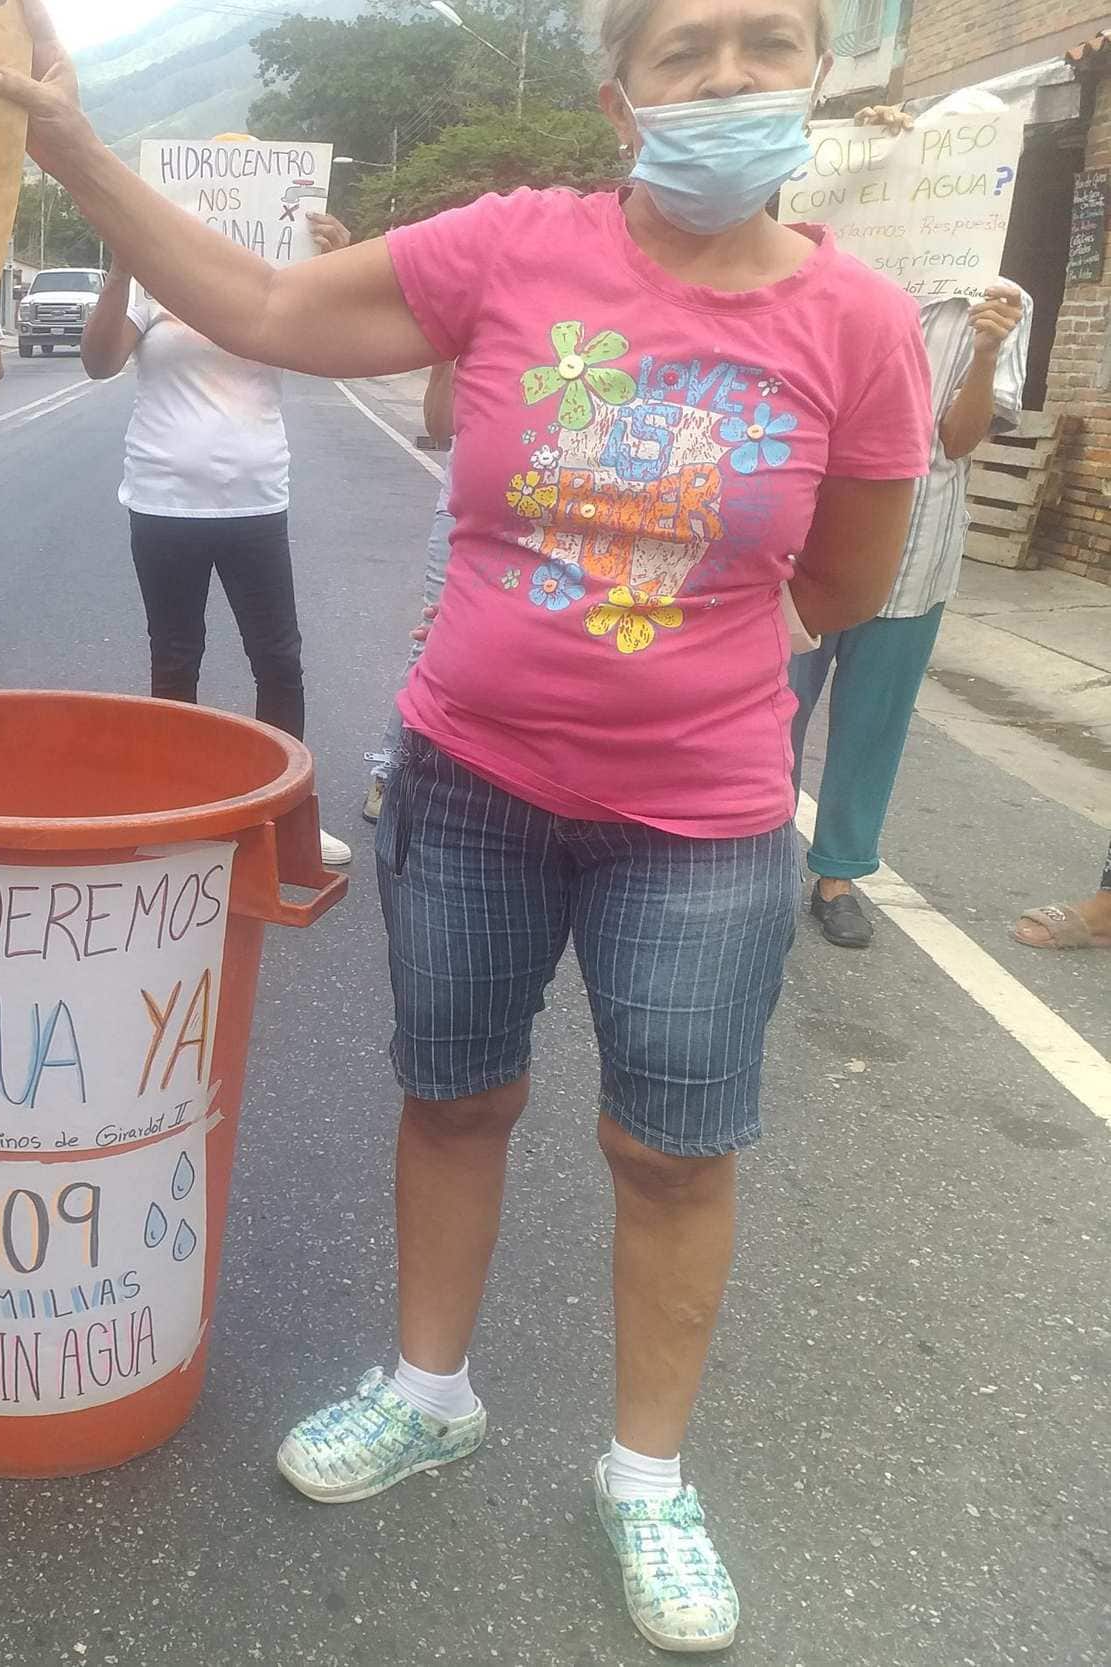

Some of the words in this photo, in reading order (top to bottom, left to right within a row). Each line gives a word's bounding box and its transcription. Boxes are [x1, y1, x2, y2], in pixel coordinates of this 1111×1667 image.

[160, 145, 315, 183] HIDROCENTRO
[921, 117, 1000, 165] PASÓ
[198, 187, 242, 211] NOS
[791, 187, 846, 214] CON
[859, 183, 891, 204] EL
[912, 166, 1014, 203] AGUA?
[276, 226, 293, 261] A
[874, 247, 980, 276] sufriendo
[928, 279, 957, 295] II
[636, 354, 765, 415] LOVE
[137, 967, 213, 1098] YA
[55, 1132, 79, 1148] de
[95, 1115, 165, 1146] Girardot
[169, 1101, 191, 1129] II
[59, 1305, 158, 1400] AGUA
